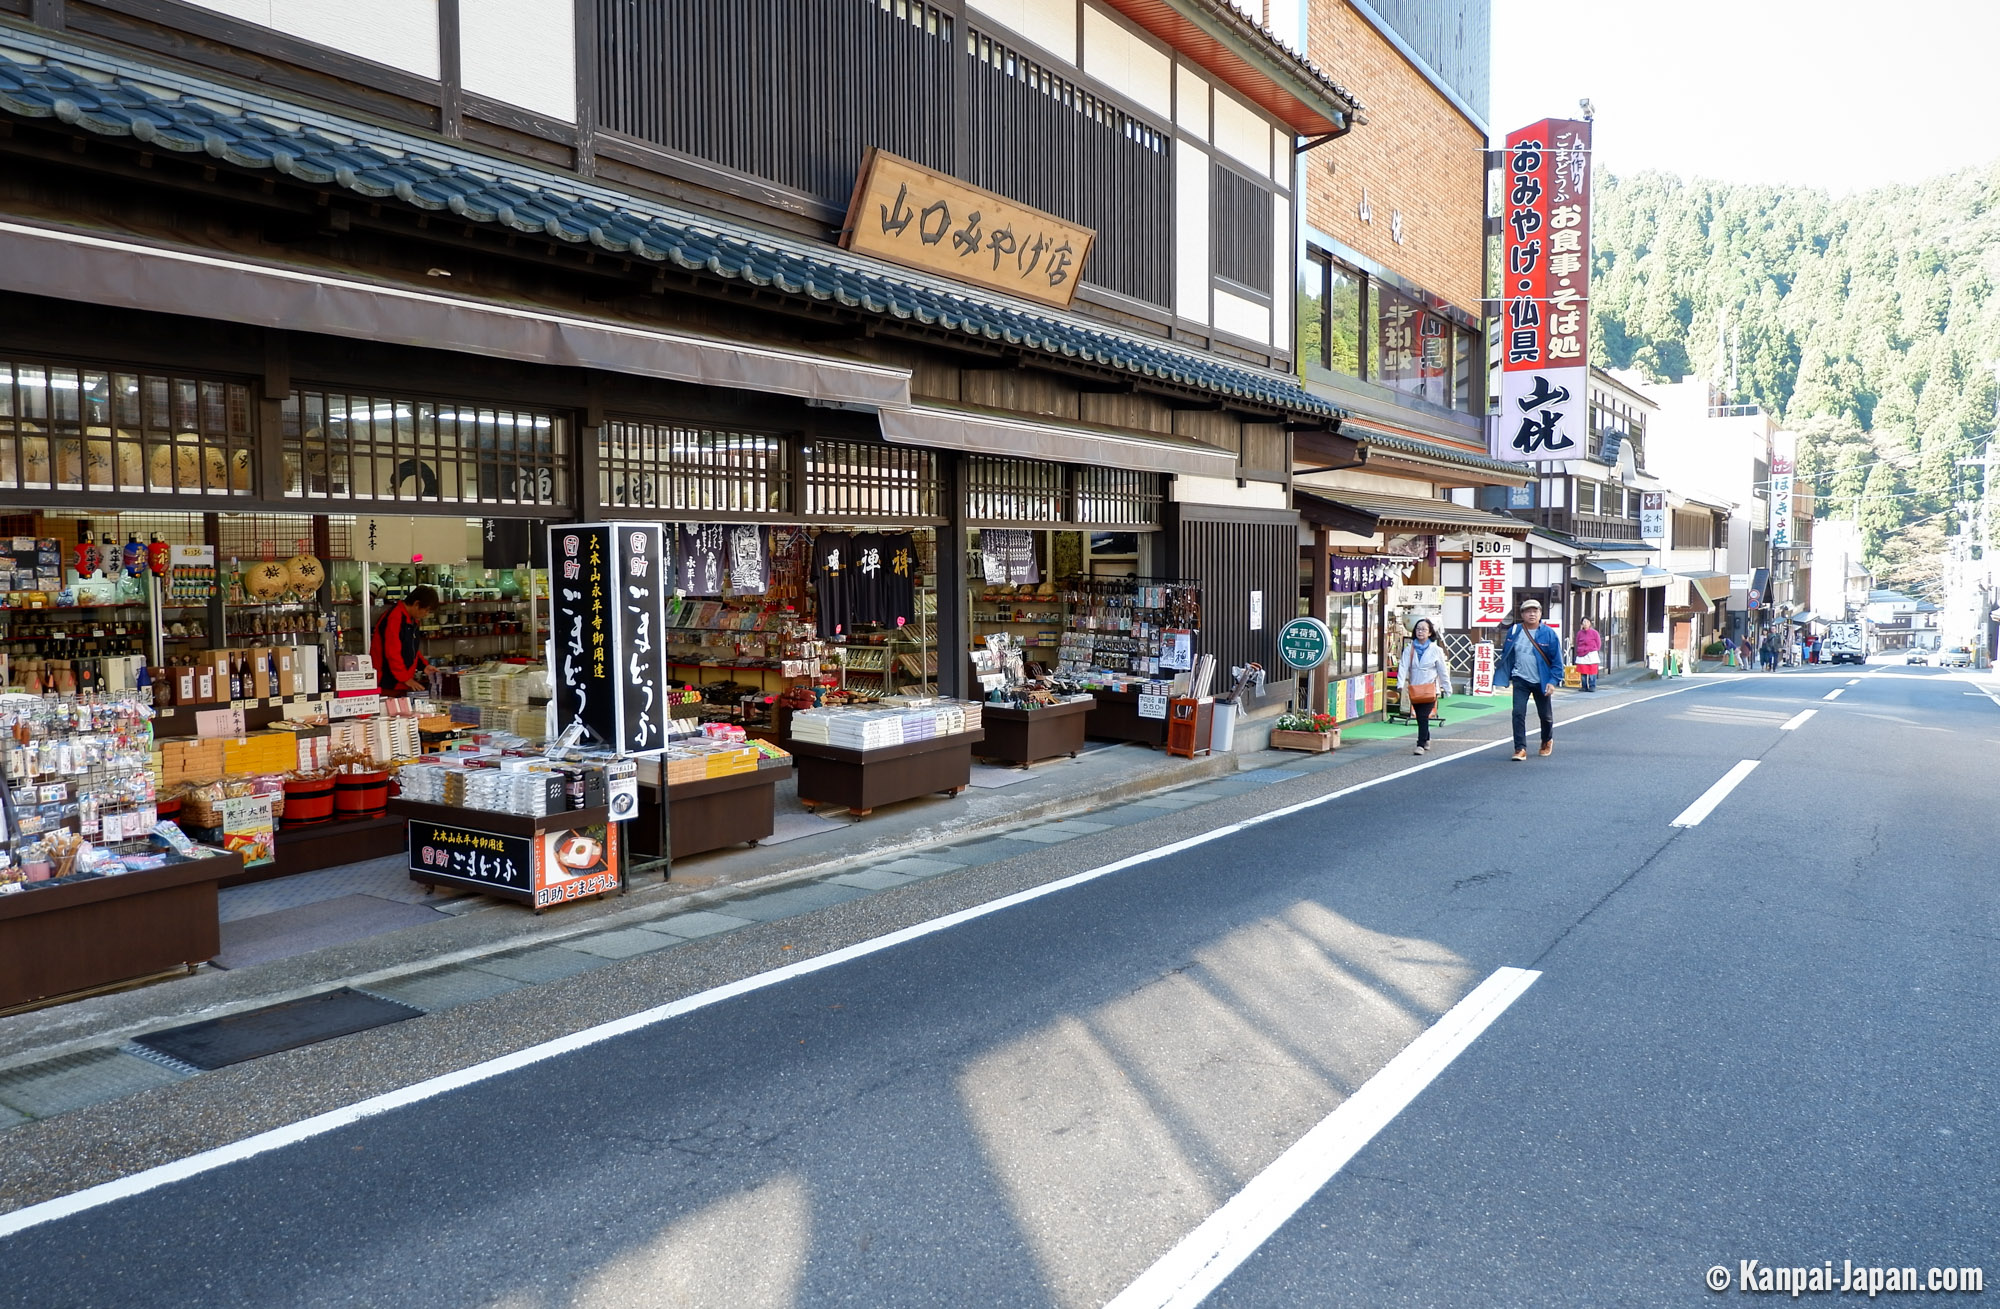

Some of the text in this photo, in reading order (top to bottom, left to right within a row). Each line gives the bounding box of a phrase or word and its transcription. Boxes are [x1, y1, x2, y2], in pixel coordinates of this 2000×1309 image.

[880, 182, 1073, 287] 山口みやげ店
[1509, 139, 1543, 364] おみやげ・仏具
[1548, 204, 1582, 359] お食事・そば処
[861, 547, 881, 580] 禅
[1476, 541, 1511, 553] 500円
[1479, 560, 1506, 614] 駐車場
[589, 534, 606, 679] 大本山永平寺御用達
[628, 585, 657, 747] ごまどうふ
[1288, 649, 1316, 661] 預り所
[1476, 646, 1491, 688] 駐車場
[226, 804, 269, 820] 寒干大根
[433, 829, 505, 852] 大本山永平寺御用達
[453, 850, 517, 882] ごまどうふ
[537, 873, 617, 906] 団助 ごまどうふ
